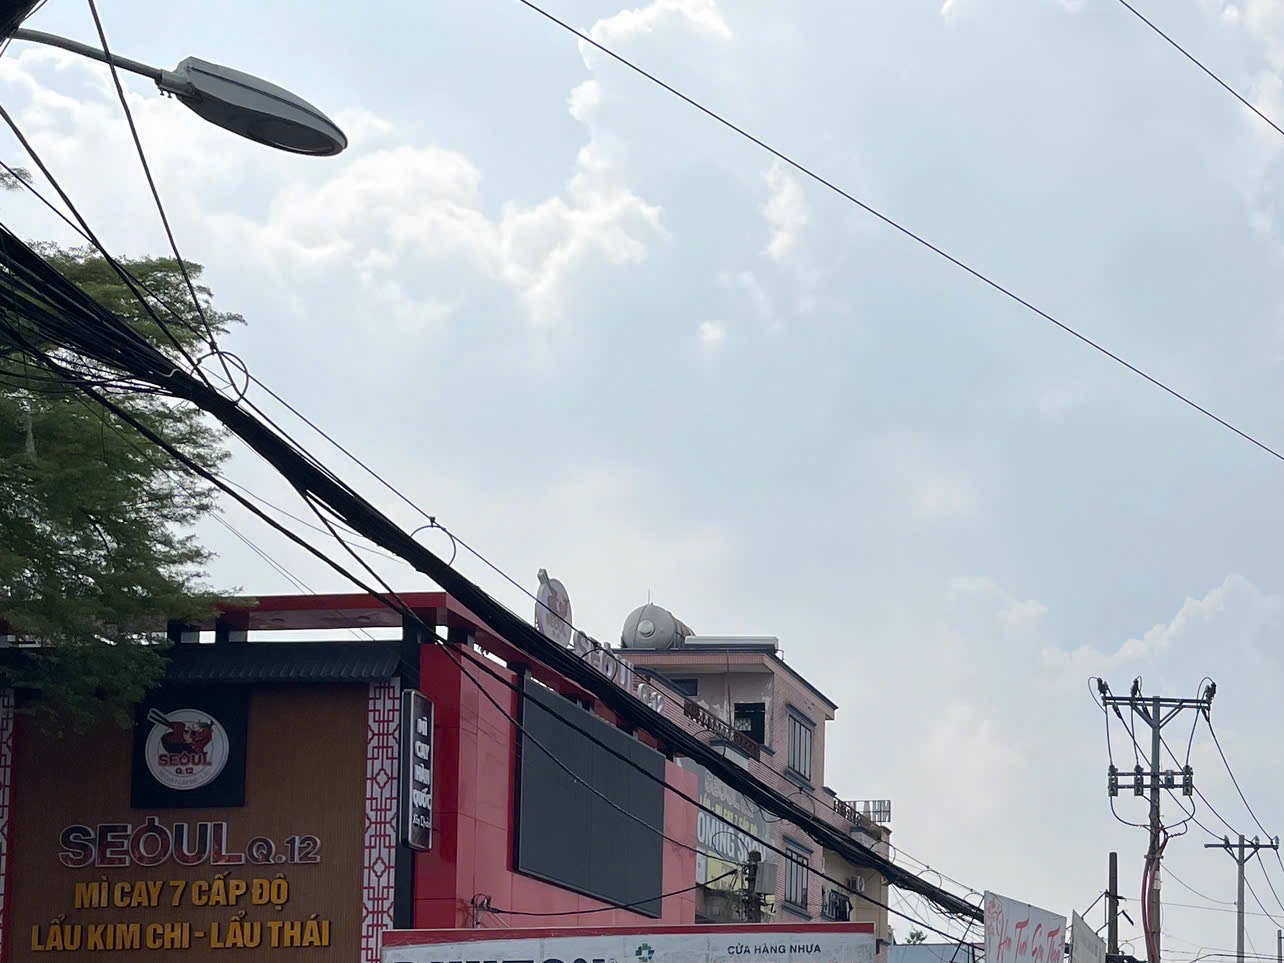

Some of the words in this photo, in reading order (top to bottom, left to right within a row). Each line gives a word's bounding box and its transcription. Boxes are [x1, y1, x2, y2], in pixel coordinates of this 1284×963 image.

[59, 816, 246, 867] SEOUL
[246, 834, 321, 864] Q.12
[697, 811, 735, 858] OMING
[75, 875, 108, 908] MÌ
[113, 880, 163, 907] CAY
[169, 881, 186, 906] 7
[192, 872, 247, 906] CẤP
[252, 873, 290, 911] ĐỘ
[32, 914, 81, 951] LẨU
[87, 923, 141, 950] KIM
[147, 922, 191, 949] CHI
[194, 930, 205, 938] -
[211, 910, 263, 949] LẨU
[268, 914, 330, 948] THÁI
[728, 942, 751, 955] CỬA
[754, 943, 786, 954] HÀNG
[789, 944, 821, 955] NHỰA
